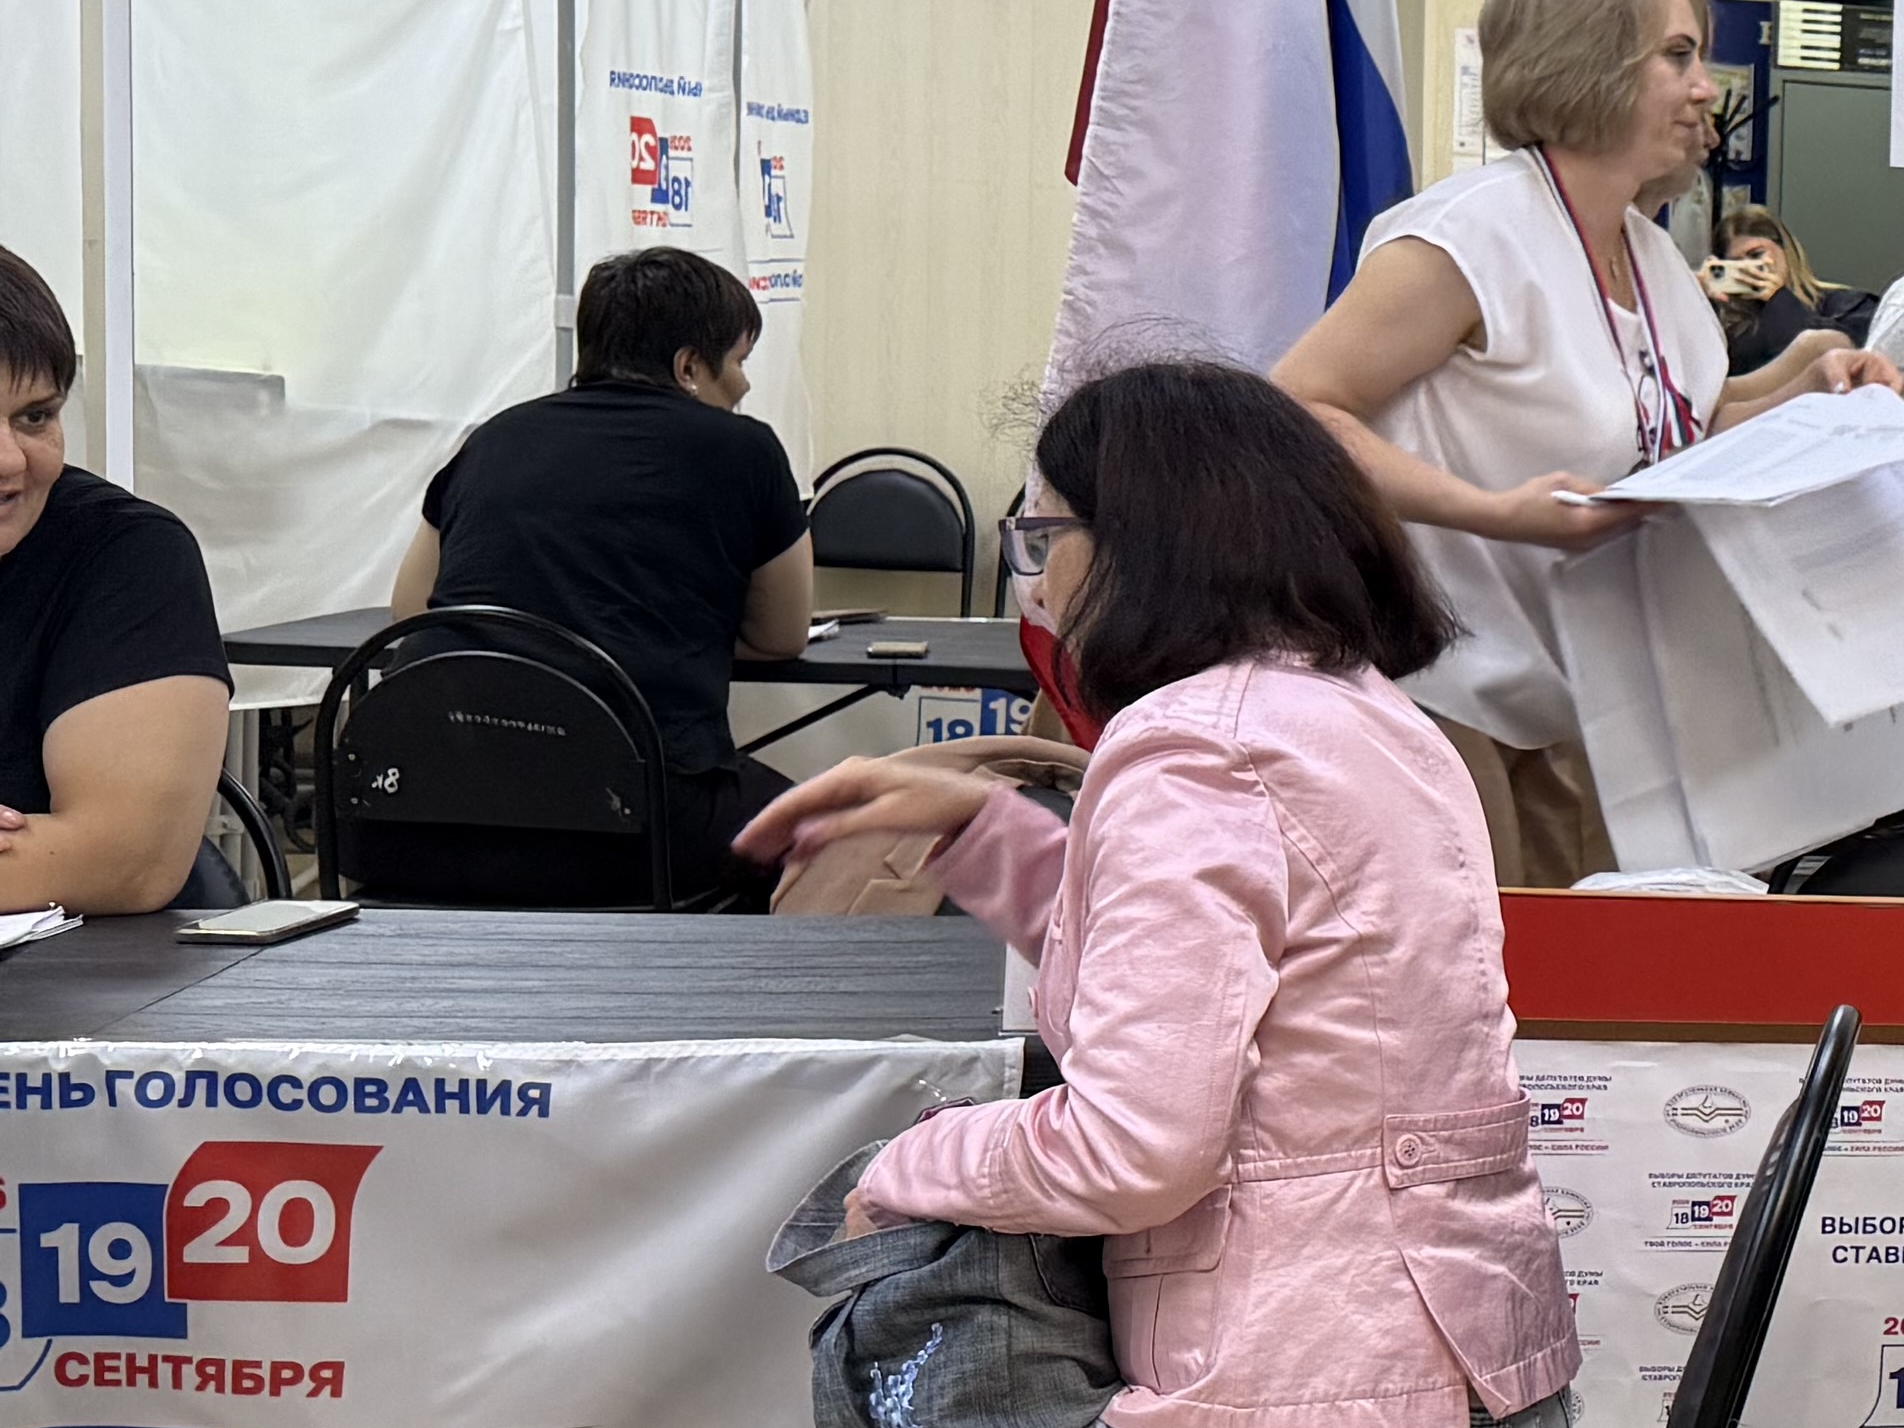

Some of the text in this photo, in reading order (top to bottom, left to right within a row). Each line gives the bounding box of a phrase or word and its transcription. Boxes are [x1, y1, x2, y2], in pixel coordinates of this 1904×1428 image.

[105, 1069, 552, 1119] ГОЛОСОВАНИЯ
[1562, 1102, 1583, 1115] 20
[1862, 1104, 1881, 1117] 20
[183, 1179, 336, 1265] 20
[1673, 1200, 1732, 1225] 18 19 20
[40, 1221, 152, 1304] 19
[54, 1351, 344, 1399] СЕНТЯБРЯ
